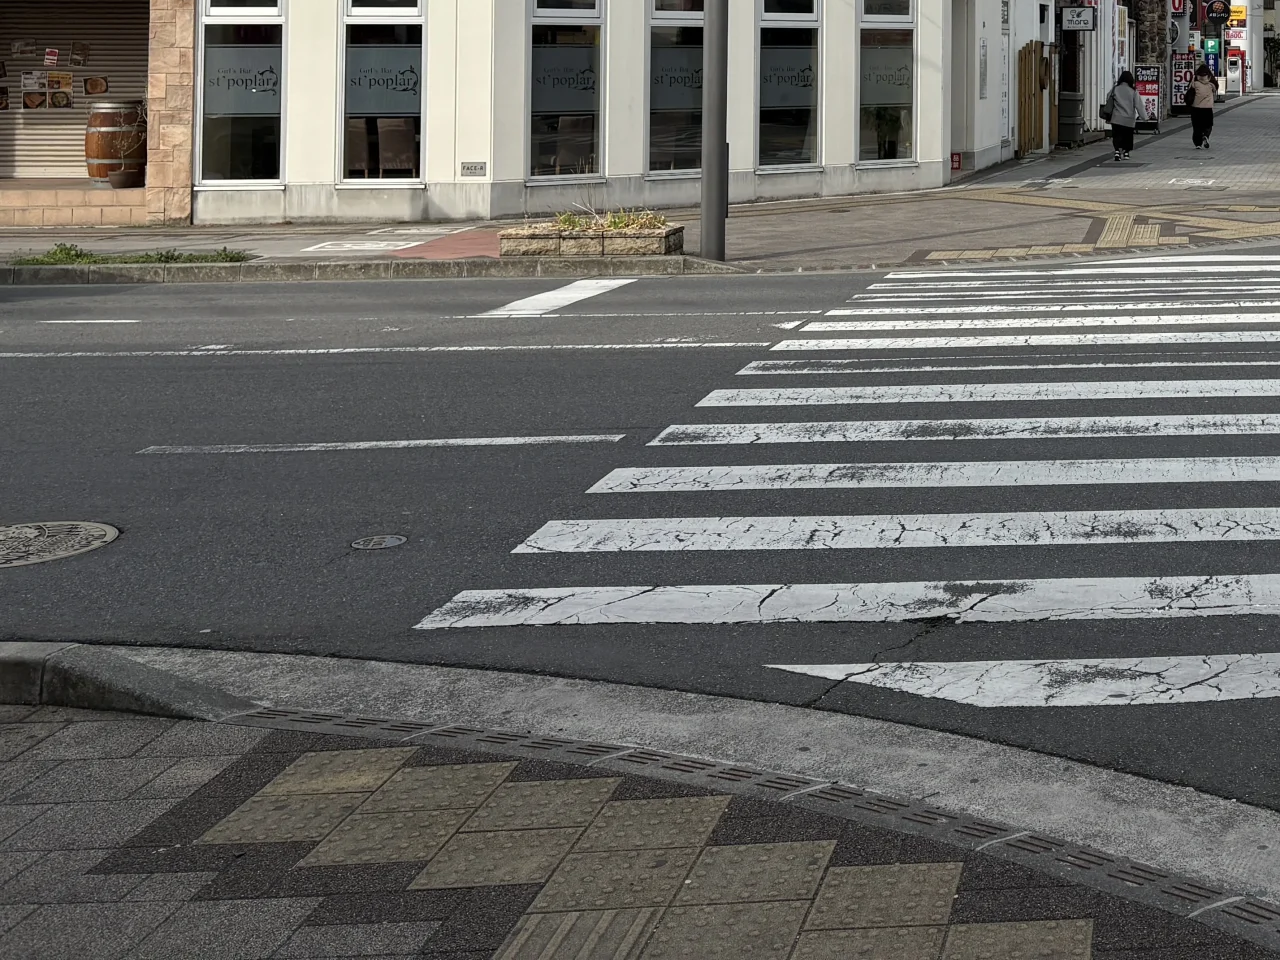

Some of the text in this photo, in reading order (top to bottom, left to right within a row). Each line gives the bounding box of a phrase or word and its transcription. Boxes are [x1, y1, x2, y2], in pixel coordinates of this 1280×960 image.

[209, 75, 272, 90] st'poplar
[350, 74, 412, 90] st'poplar
[535, 73, 592, 88] st'poplar
[763, 72, 811, 86] st'poplar
